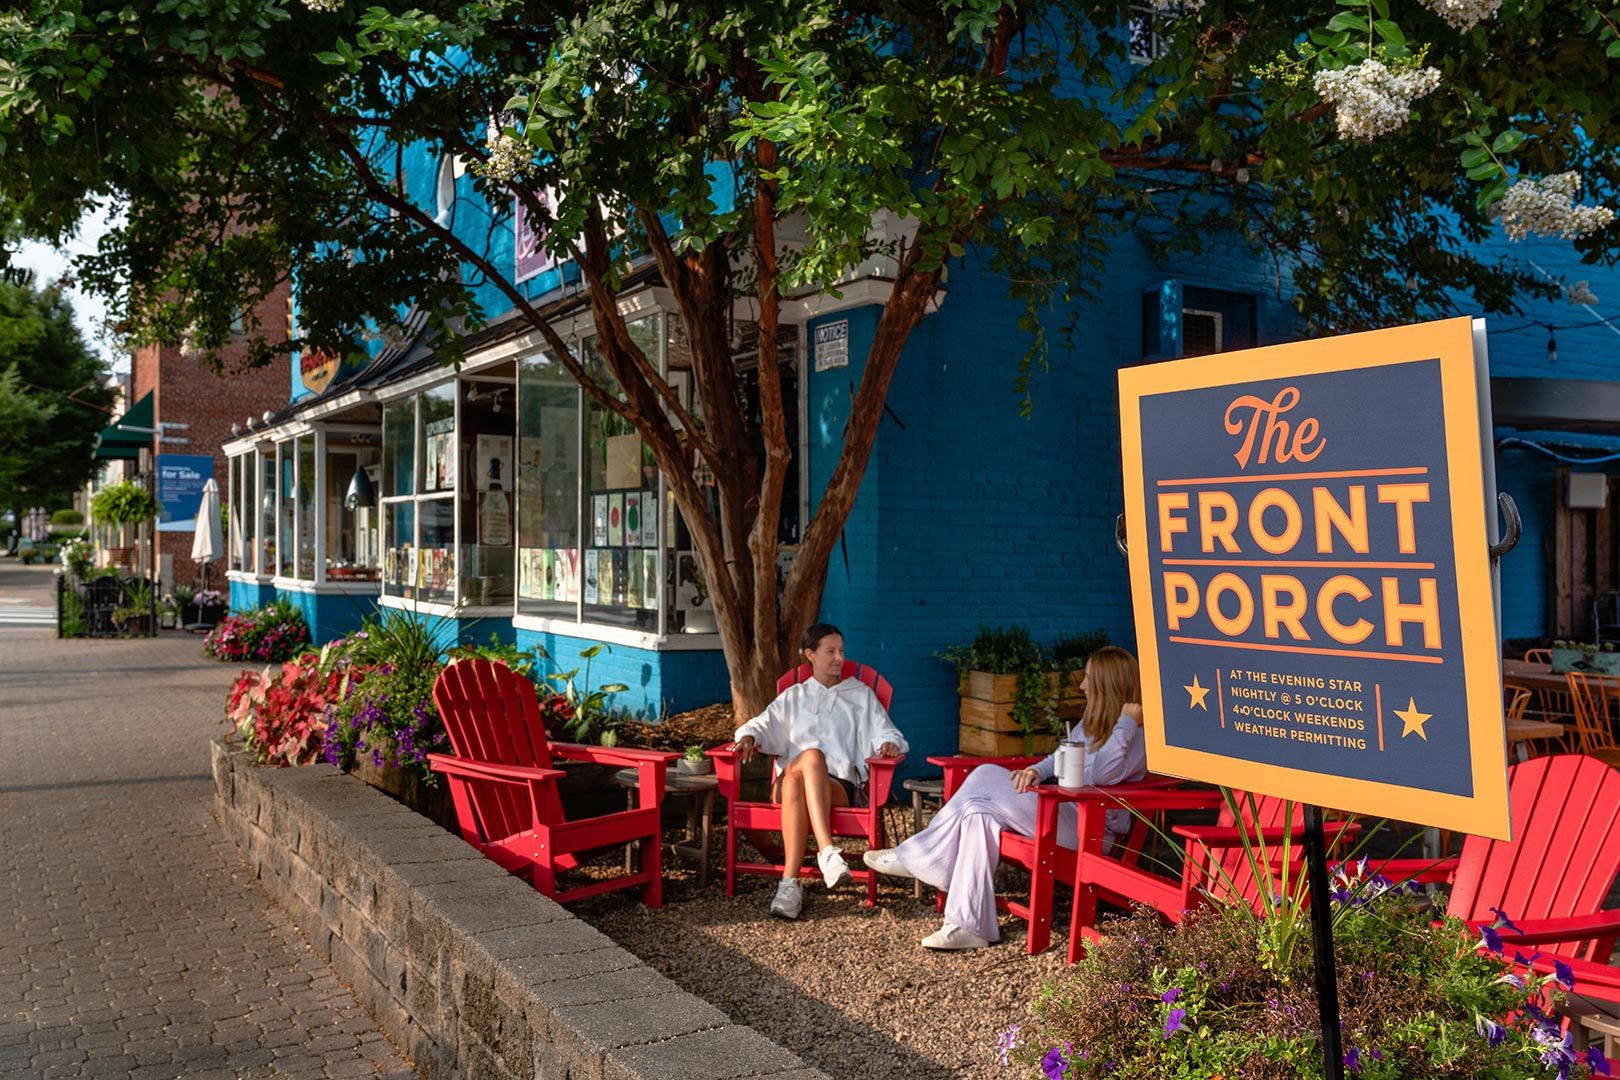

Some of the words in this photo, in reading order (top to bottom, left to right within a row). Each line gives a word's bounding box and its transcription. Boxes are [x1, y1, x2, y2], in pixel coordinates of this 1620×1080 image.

[816, 324, 846, 343] NOTICE
[1224, 386, 1327, 470] The
[162, 470, 177, 479] for
[178, 470, 201, 480] Sale
[1157, 482, 1431, 555] FRONT
[1162, 571, 1442, 650] PORCH
[1230, 669, 1243, 680] AT
[1246, 671, 1267, 683] THE
[1271, 673, 1325, 689] EVENING
[1329, 679, 1362, 692] STAR
[1231, 686, 1277, 702] NIGHTLY
[1280, 692, 1291, 705] @
[1295, 694, 1302, 705] 5
[1306, 695, 1363, 712] O'CLOCK
[1294, 712, 1365, 731] WEEKENDS
[1234, 720, 1287, 739] WEATHER
[1290, 729, 1367, 750] PERMITTING
